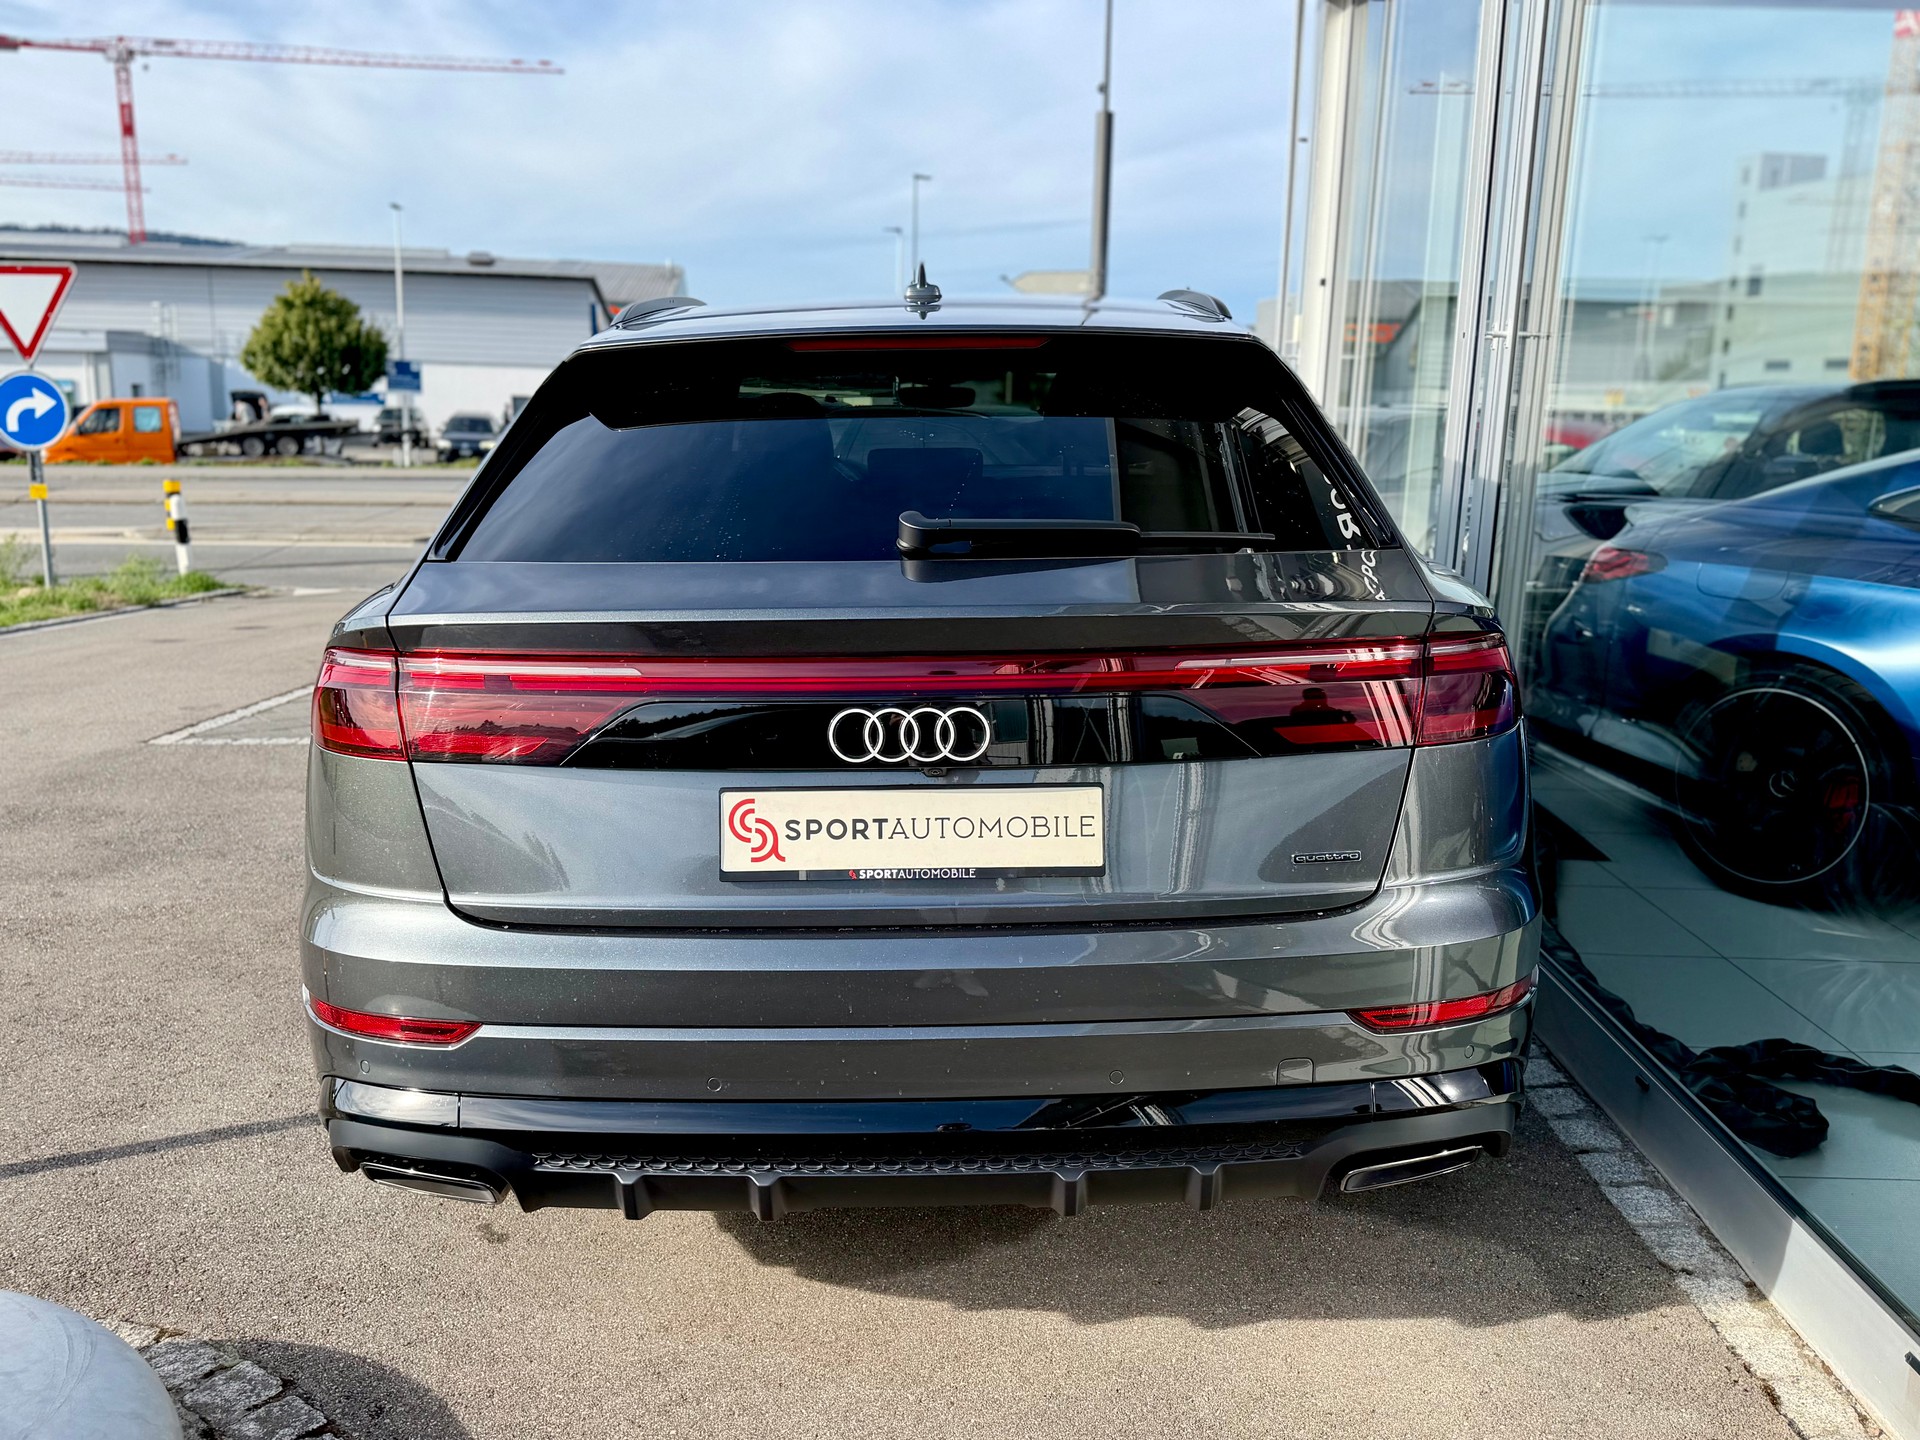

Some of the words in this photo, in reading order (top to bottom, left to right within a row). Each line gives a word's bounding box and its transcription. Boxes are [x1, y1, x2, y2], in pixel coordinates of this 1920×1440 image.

[785, 815, 1096, 841] SPORTAUTOMOBILE
[1295, 853, 1359, 863] quattro
[859, 868, 976, 879] SPORTAUTOMOBILE
